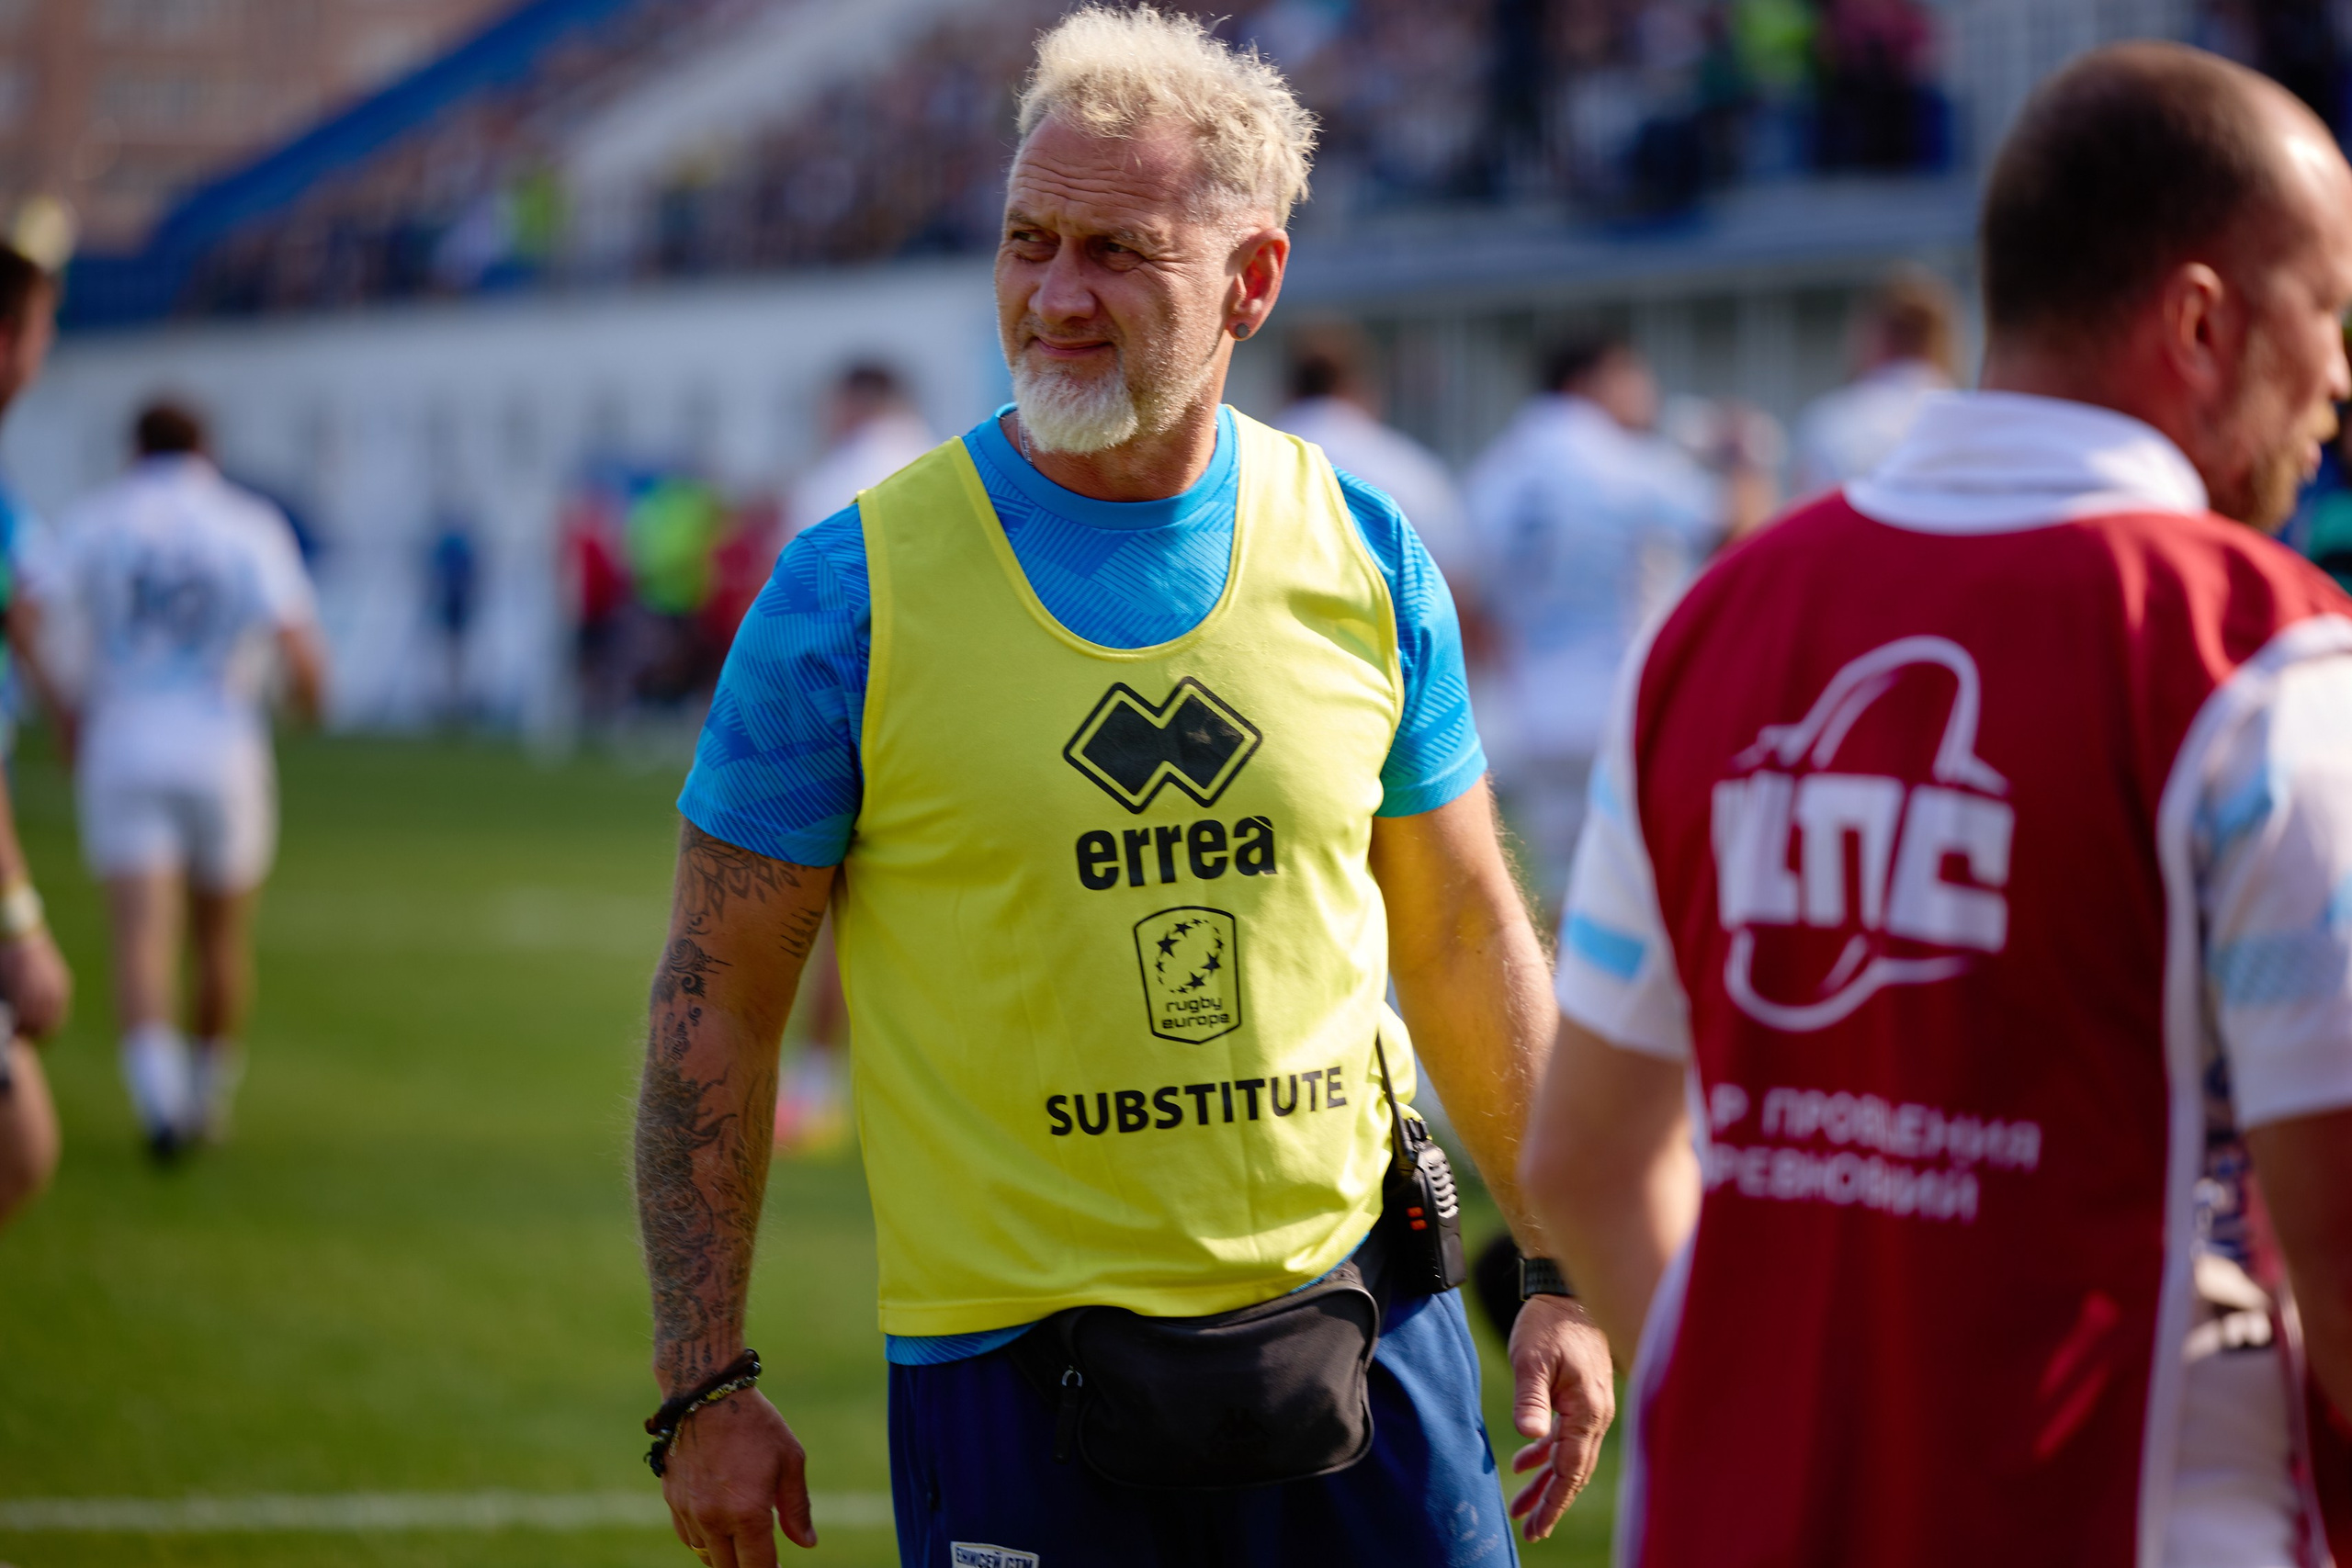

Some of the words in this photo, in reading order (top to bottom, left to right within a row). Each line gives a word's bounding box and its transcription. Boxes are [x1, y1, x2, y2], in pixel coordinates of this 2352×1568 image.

[1166, 996, 1223, 1014] rugby
[1162, 1013, 1231, 1029] europe
[1046, 1066, 1349, 1136] SUBSTITUTE
